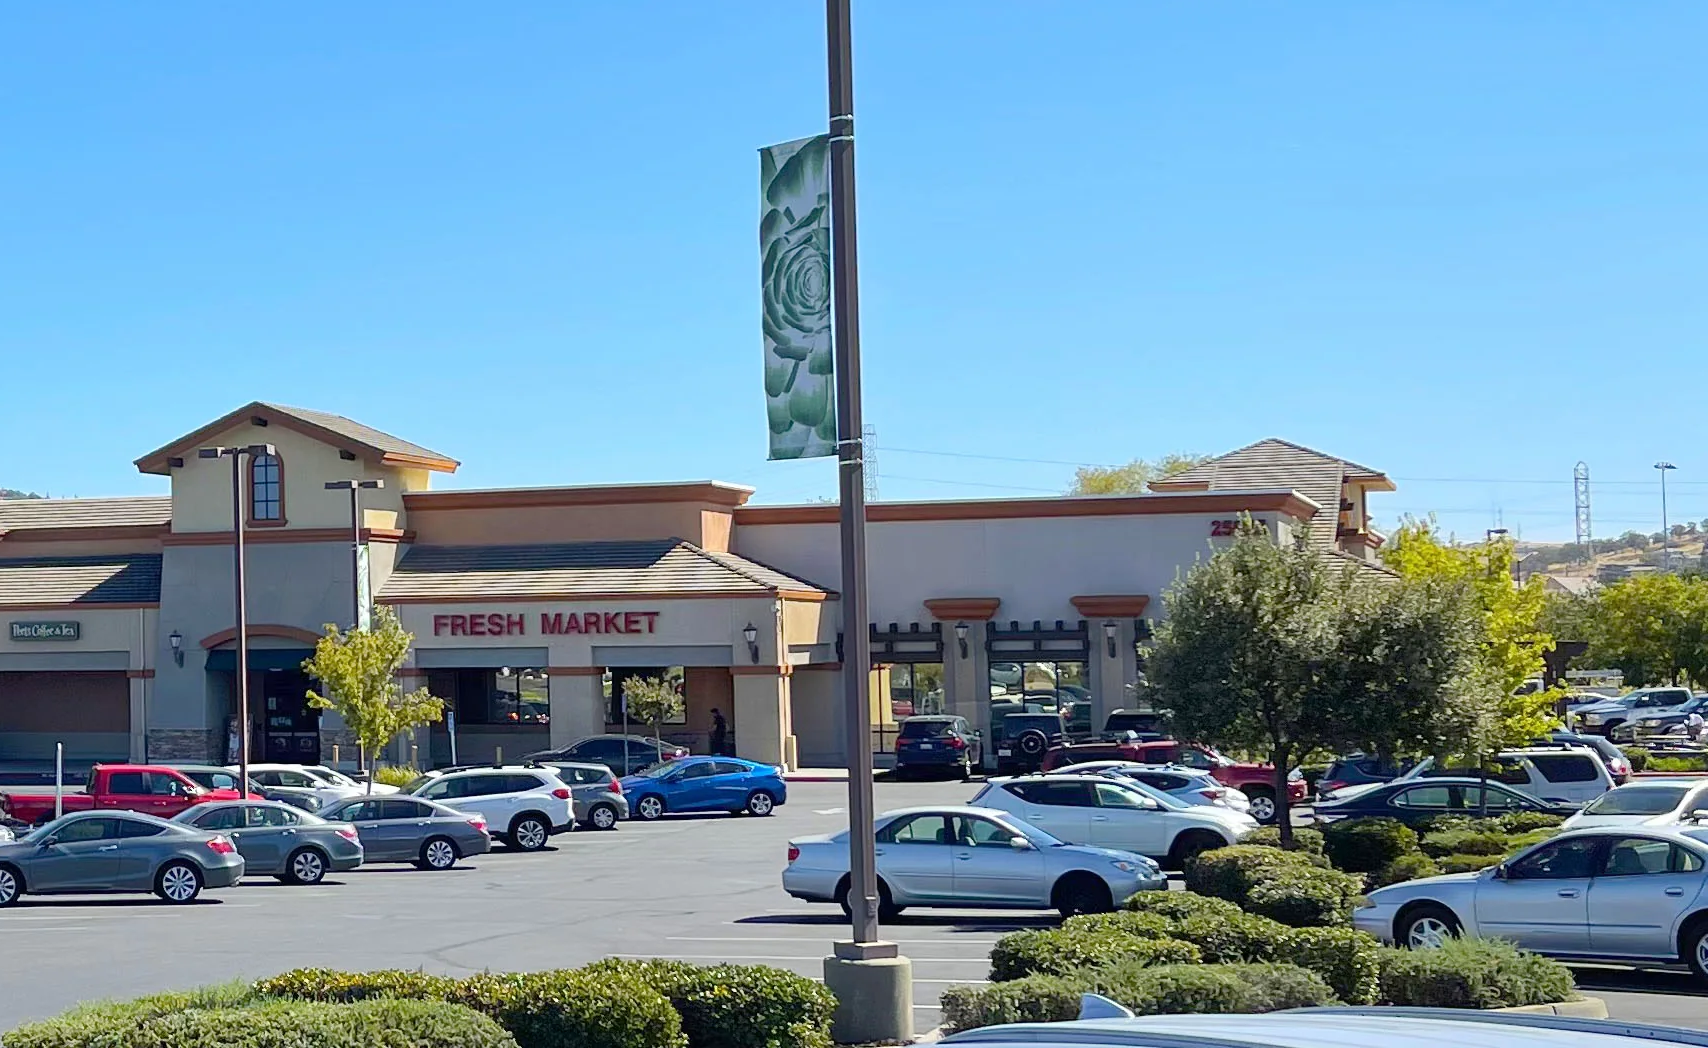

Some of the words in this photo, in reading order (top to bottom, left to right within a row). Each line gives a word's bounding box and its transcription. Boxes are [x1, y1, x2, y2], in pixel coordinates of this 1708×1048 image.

[60, 623, 75, 636] Tea
[433, 613, 526, 636] FRESH
[541, 611, 661, 634] MARKET
